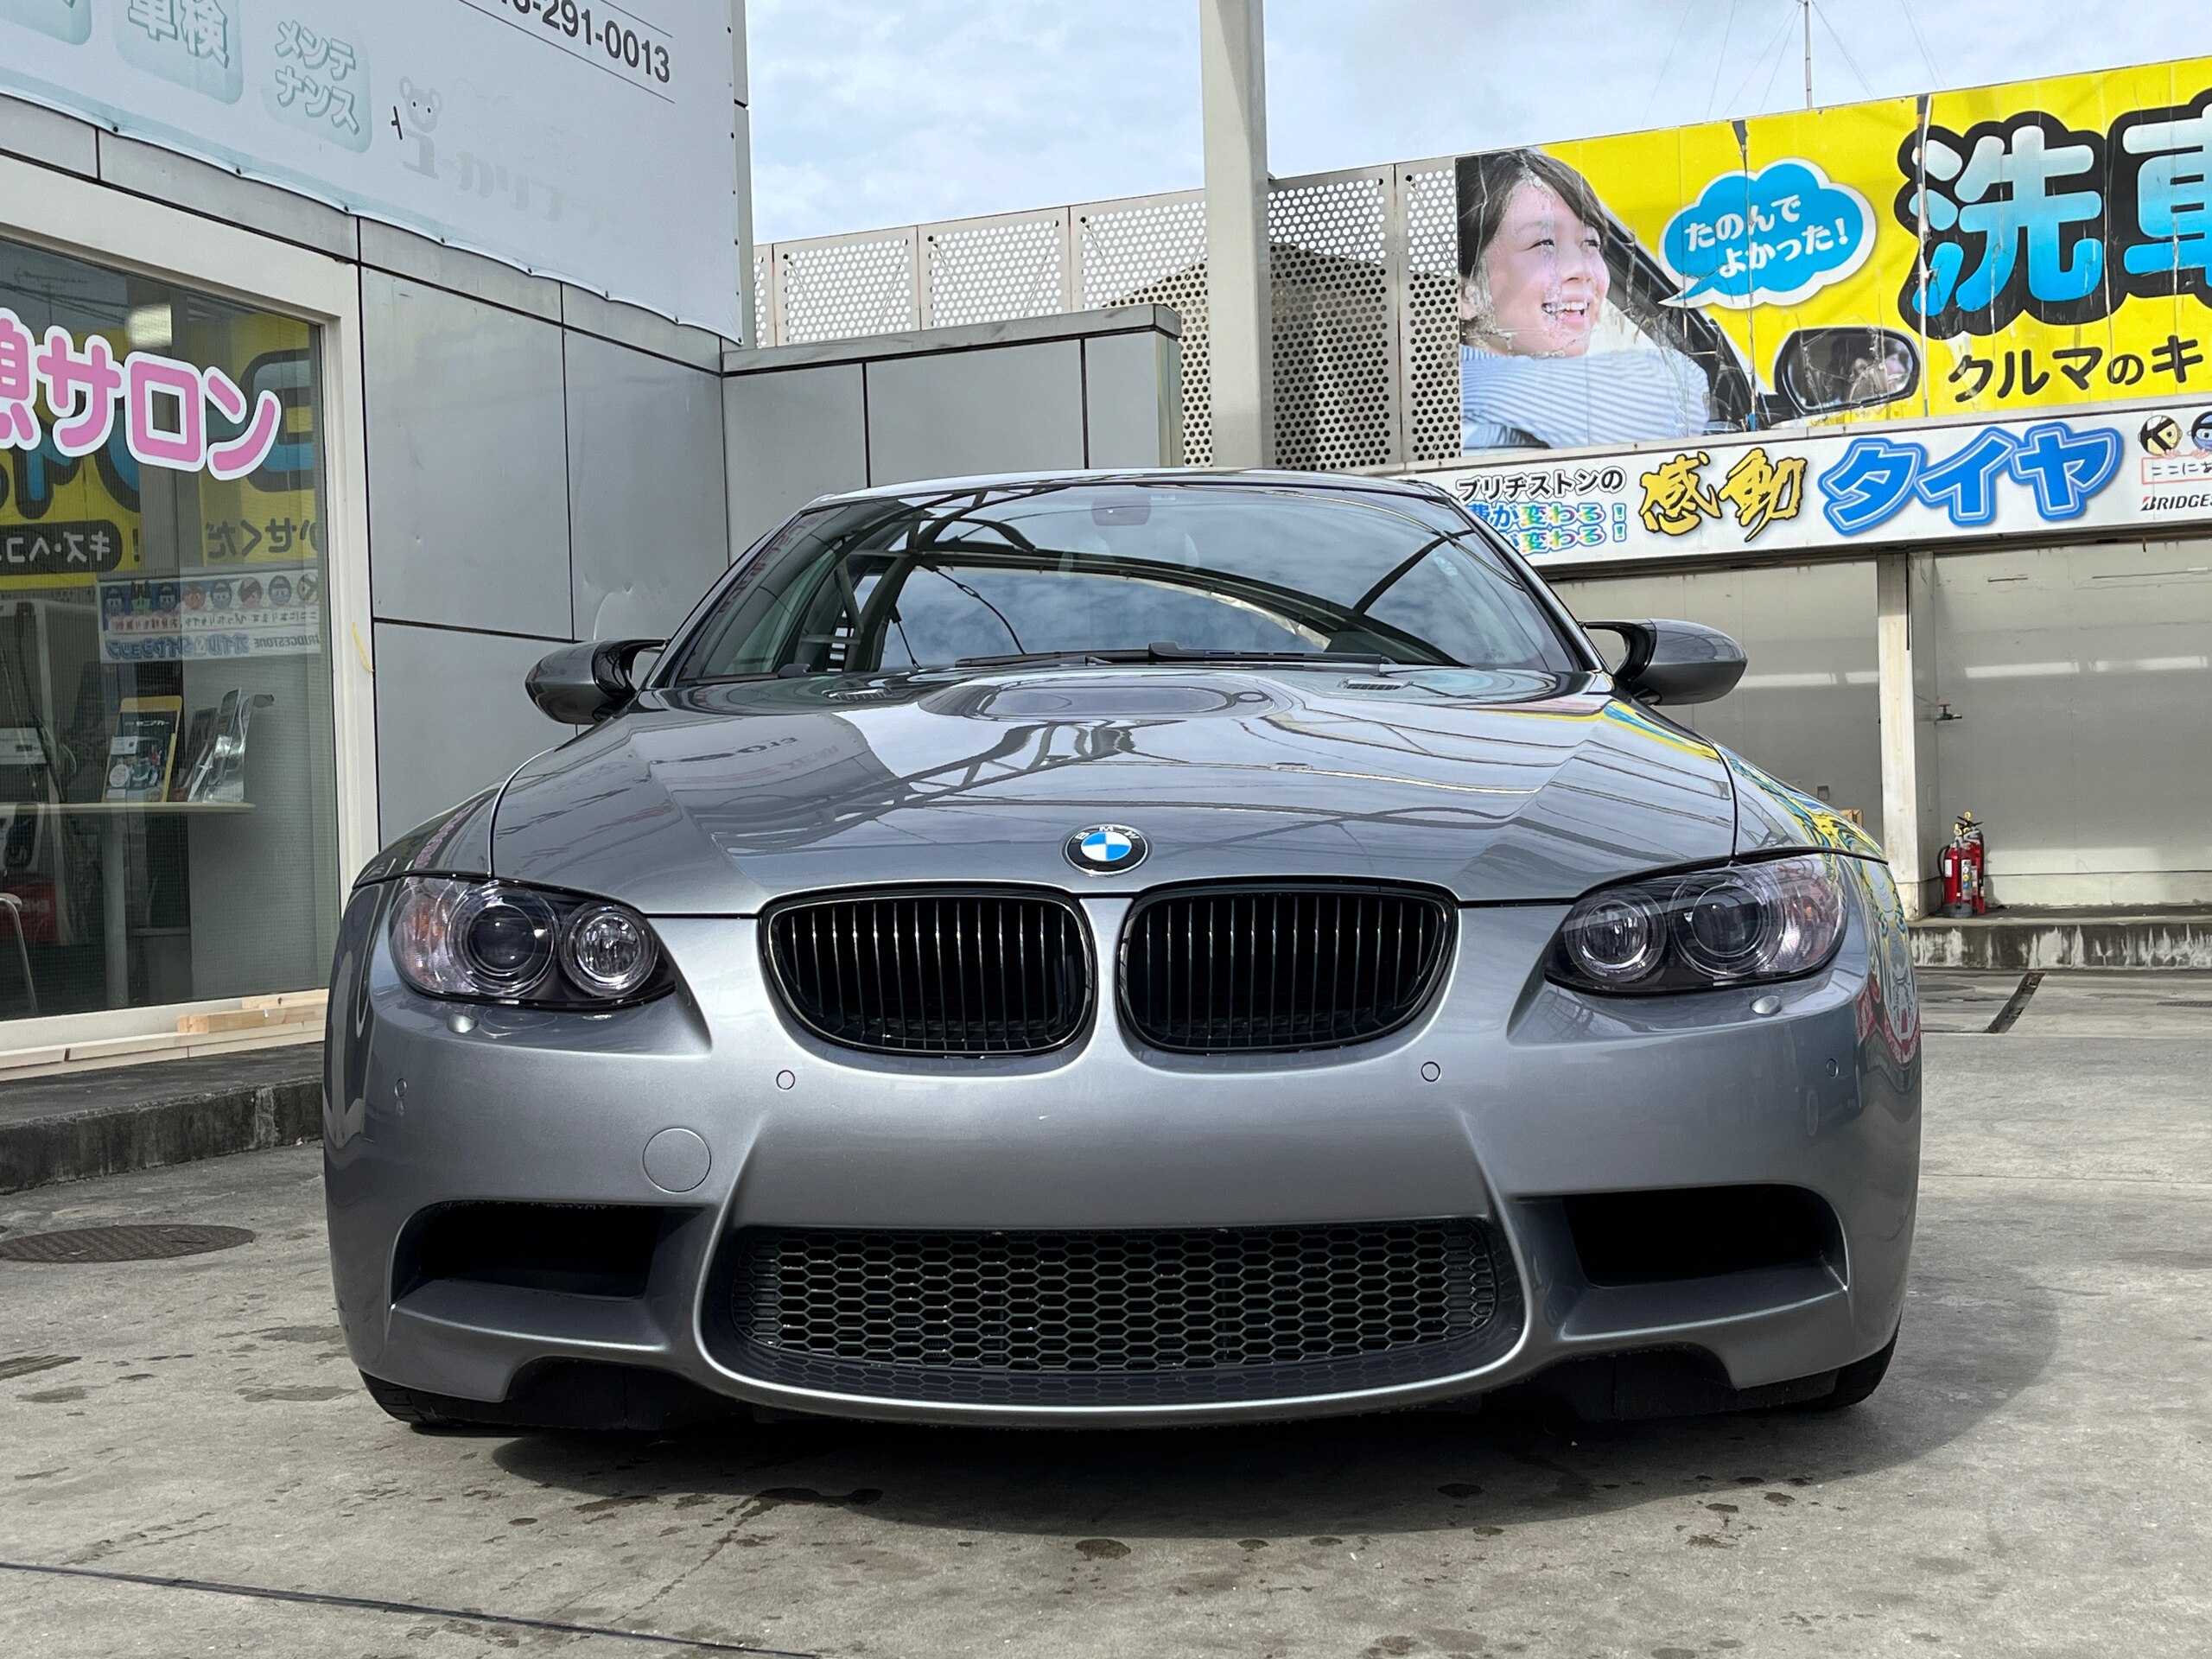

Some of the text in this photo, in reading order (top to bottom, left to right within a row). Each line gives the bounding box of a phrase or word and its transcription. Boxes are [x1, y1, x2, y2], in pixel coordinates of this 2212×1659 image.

[275, 20, 356, 81] メンテ
[501, 0, 671, 84] -291-0013
[275, 65, 360, 136] ナンス
[1684, 194, 1802, 252] たのんで
[1719, 217, 1849, 278] よかった!
[1457, 467, 1626, 505] ブリヂストンの
[1640, 422, 2124, 543] 感動 タイヤ
[2140, 493, 2212, 512] BRIDGE
[1074, 825, 1141, 841] BMW
